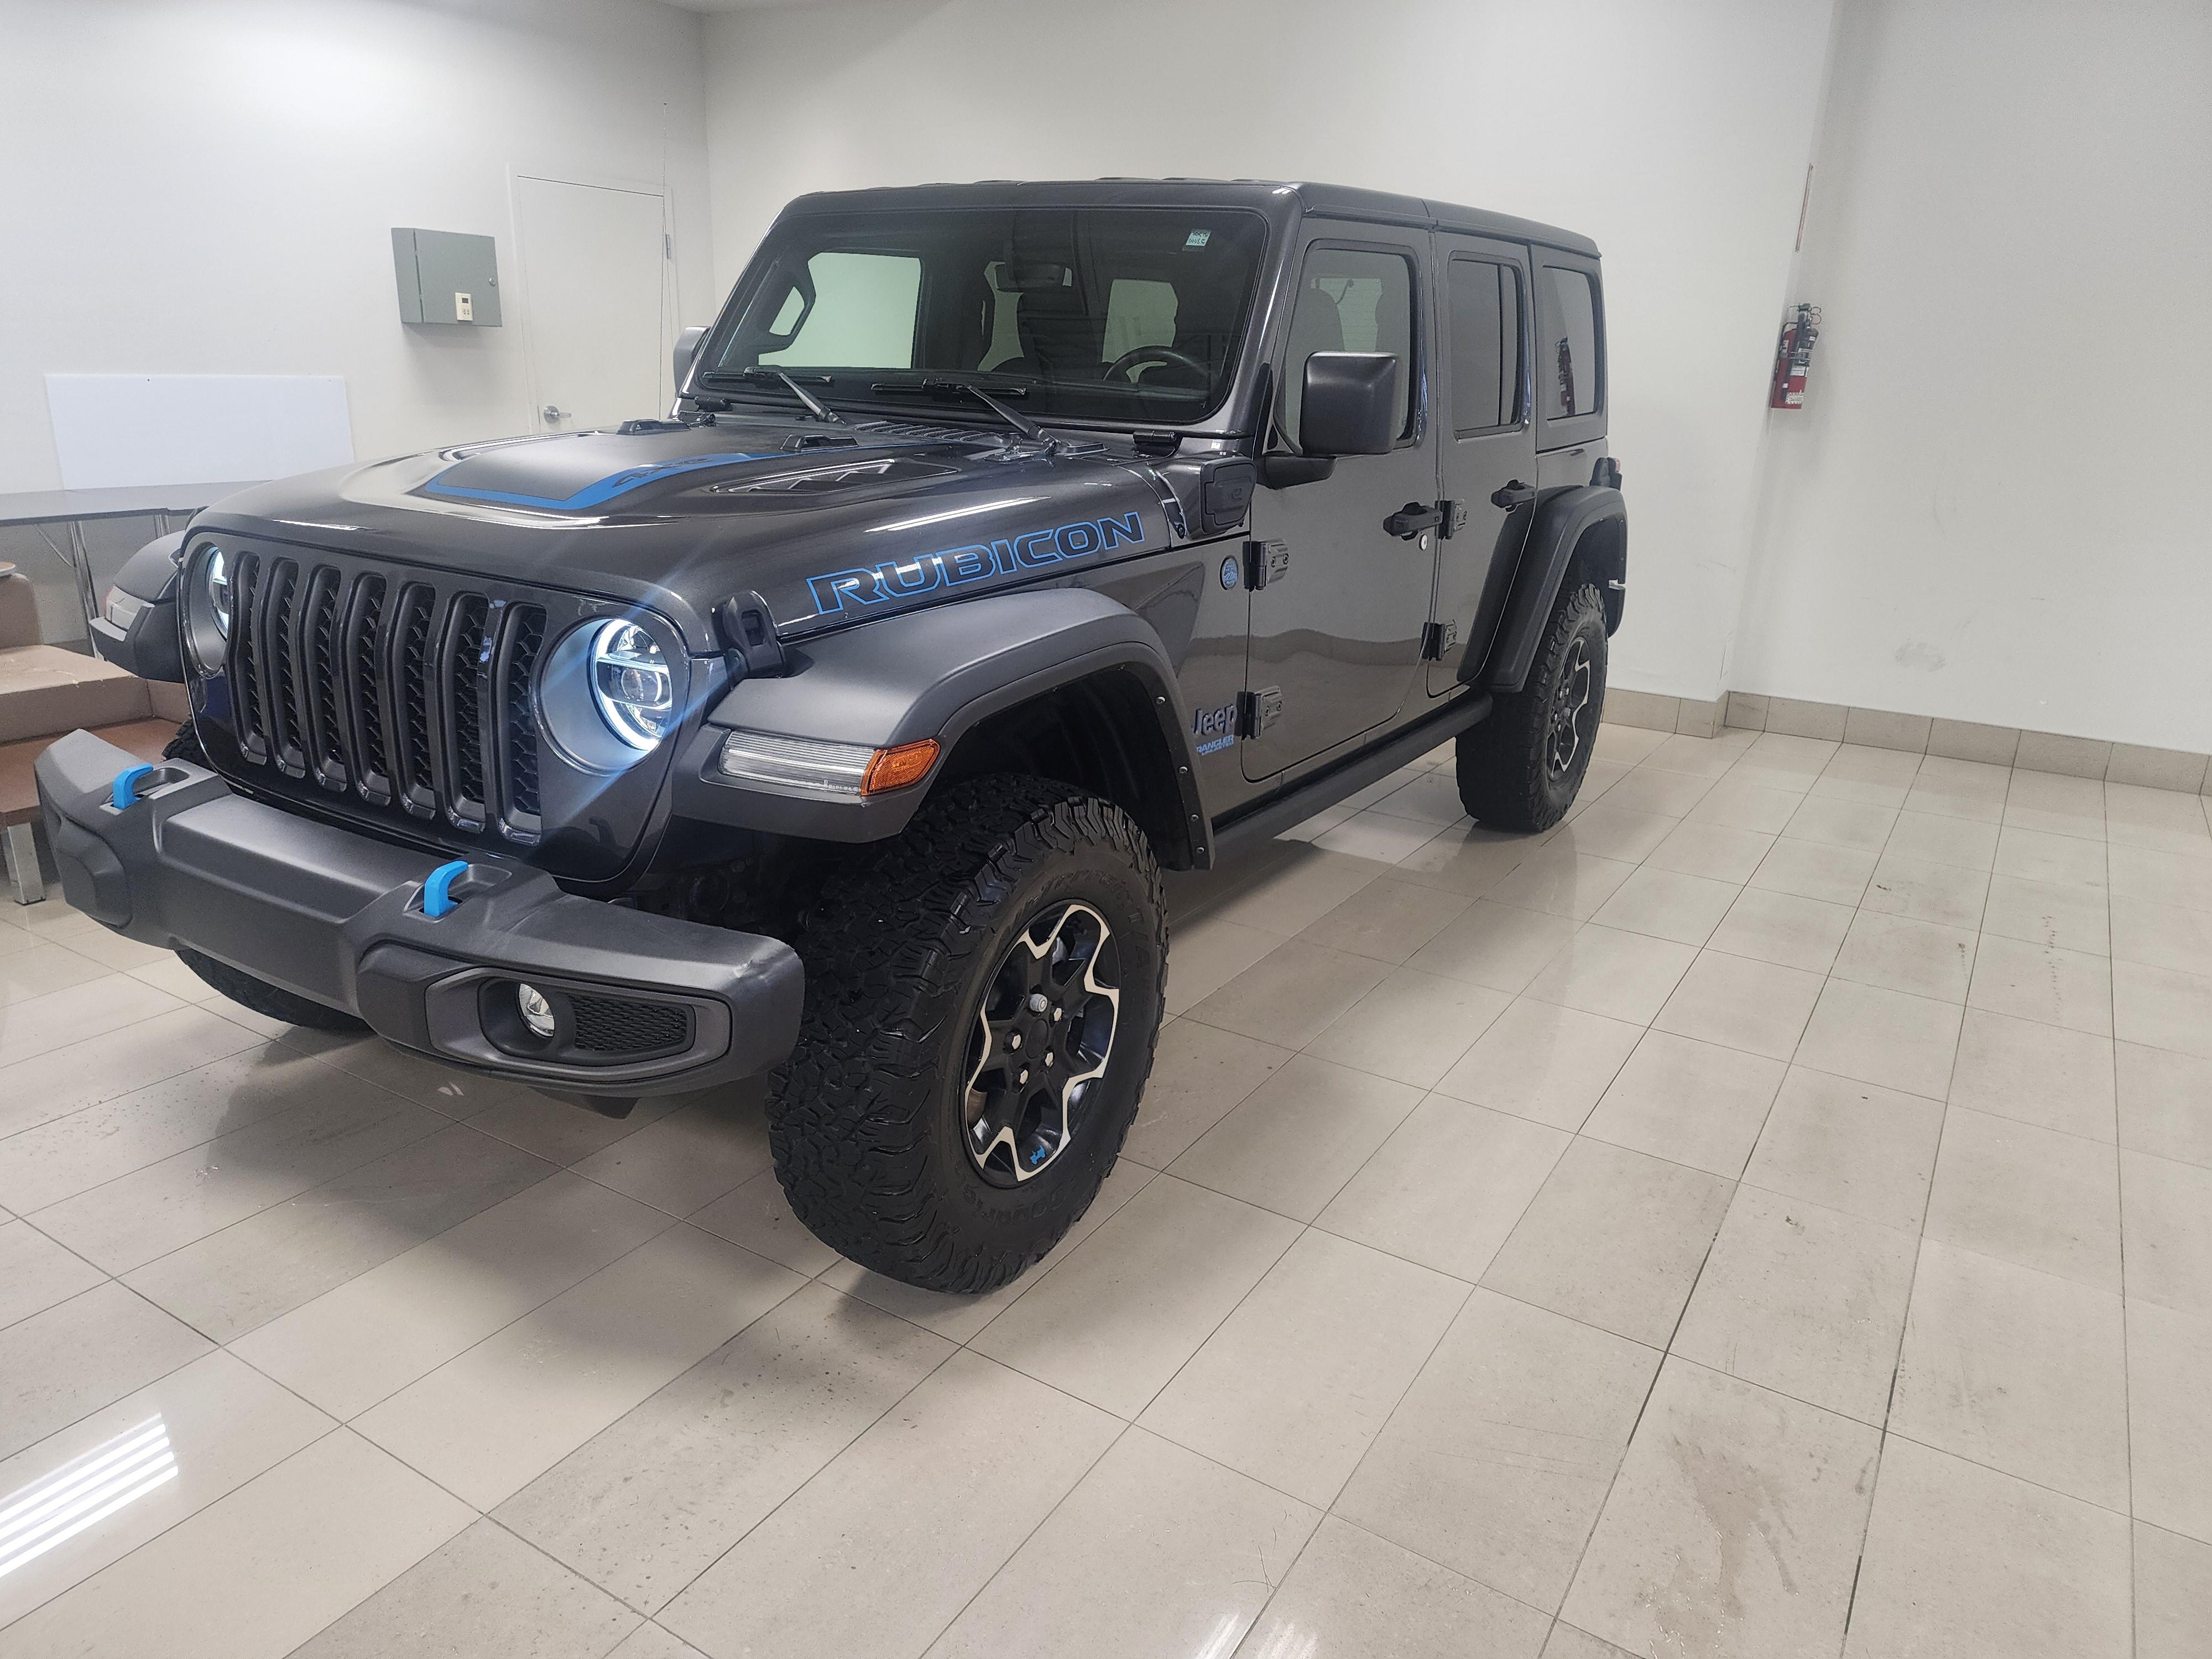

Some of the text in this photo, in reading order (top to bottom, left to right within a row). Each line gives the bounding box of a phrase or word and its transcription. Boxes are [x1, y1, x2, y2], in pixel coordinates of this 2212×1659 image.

[806, 512, 1145, 614] RUBICON
[1194, 705, 1238, 735] Jeep
[1196, 734, 1234, 753] RANGLER
